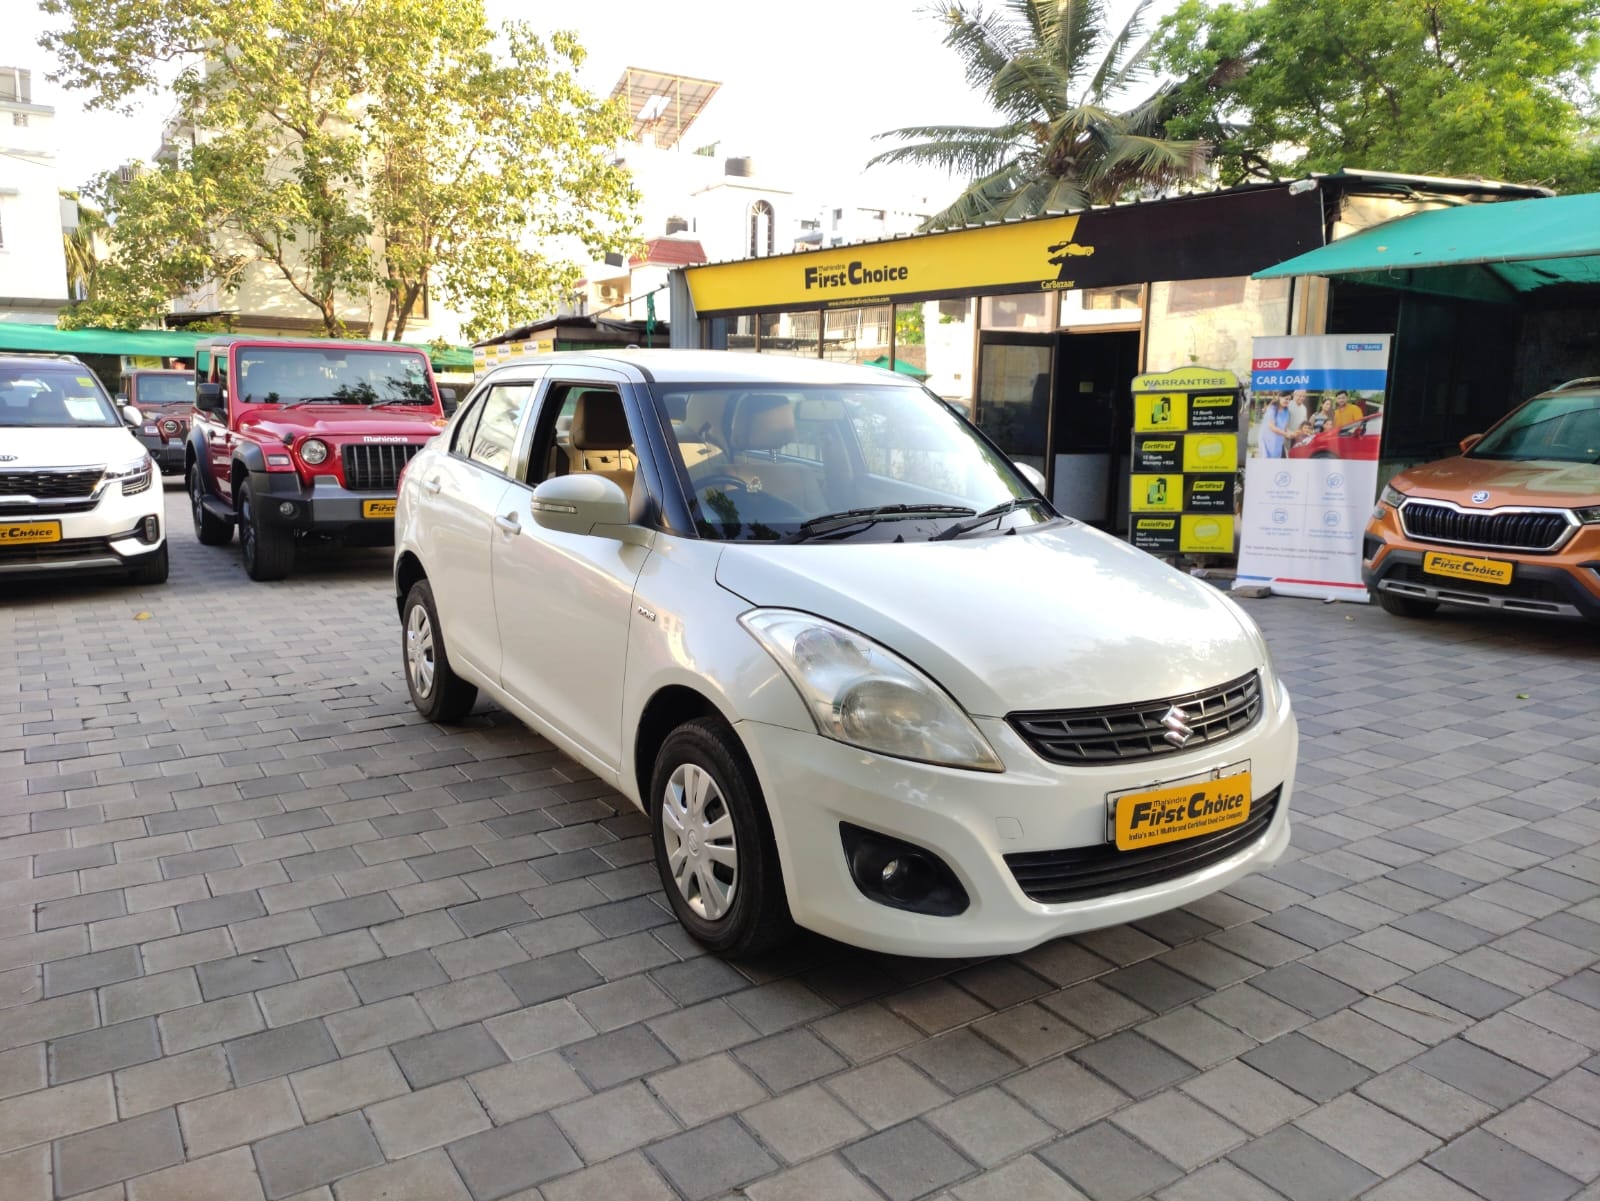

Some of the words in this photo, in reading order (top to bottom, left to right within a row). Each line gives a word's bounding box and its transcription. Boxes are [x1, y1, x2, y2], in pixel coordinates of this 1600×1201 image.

[1041, 280, 1075, 289] CarBazaar
[1256, 360, 1280, 368] USED
[1143, 377, 1226, 387] WARRANTREE
[1256, 376, 1277, 385] CAR
[1279, 375, 1309, 385] LOAN
[1153, 796, 1187, 807] Mahindra
[1129, 831, 1147, 841] India's
[1160, 825, 1187, 835] Multibrand
